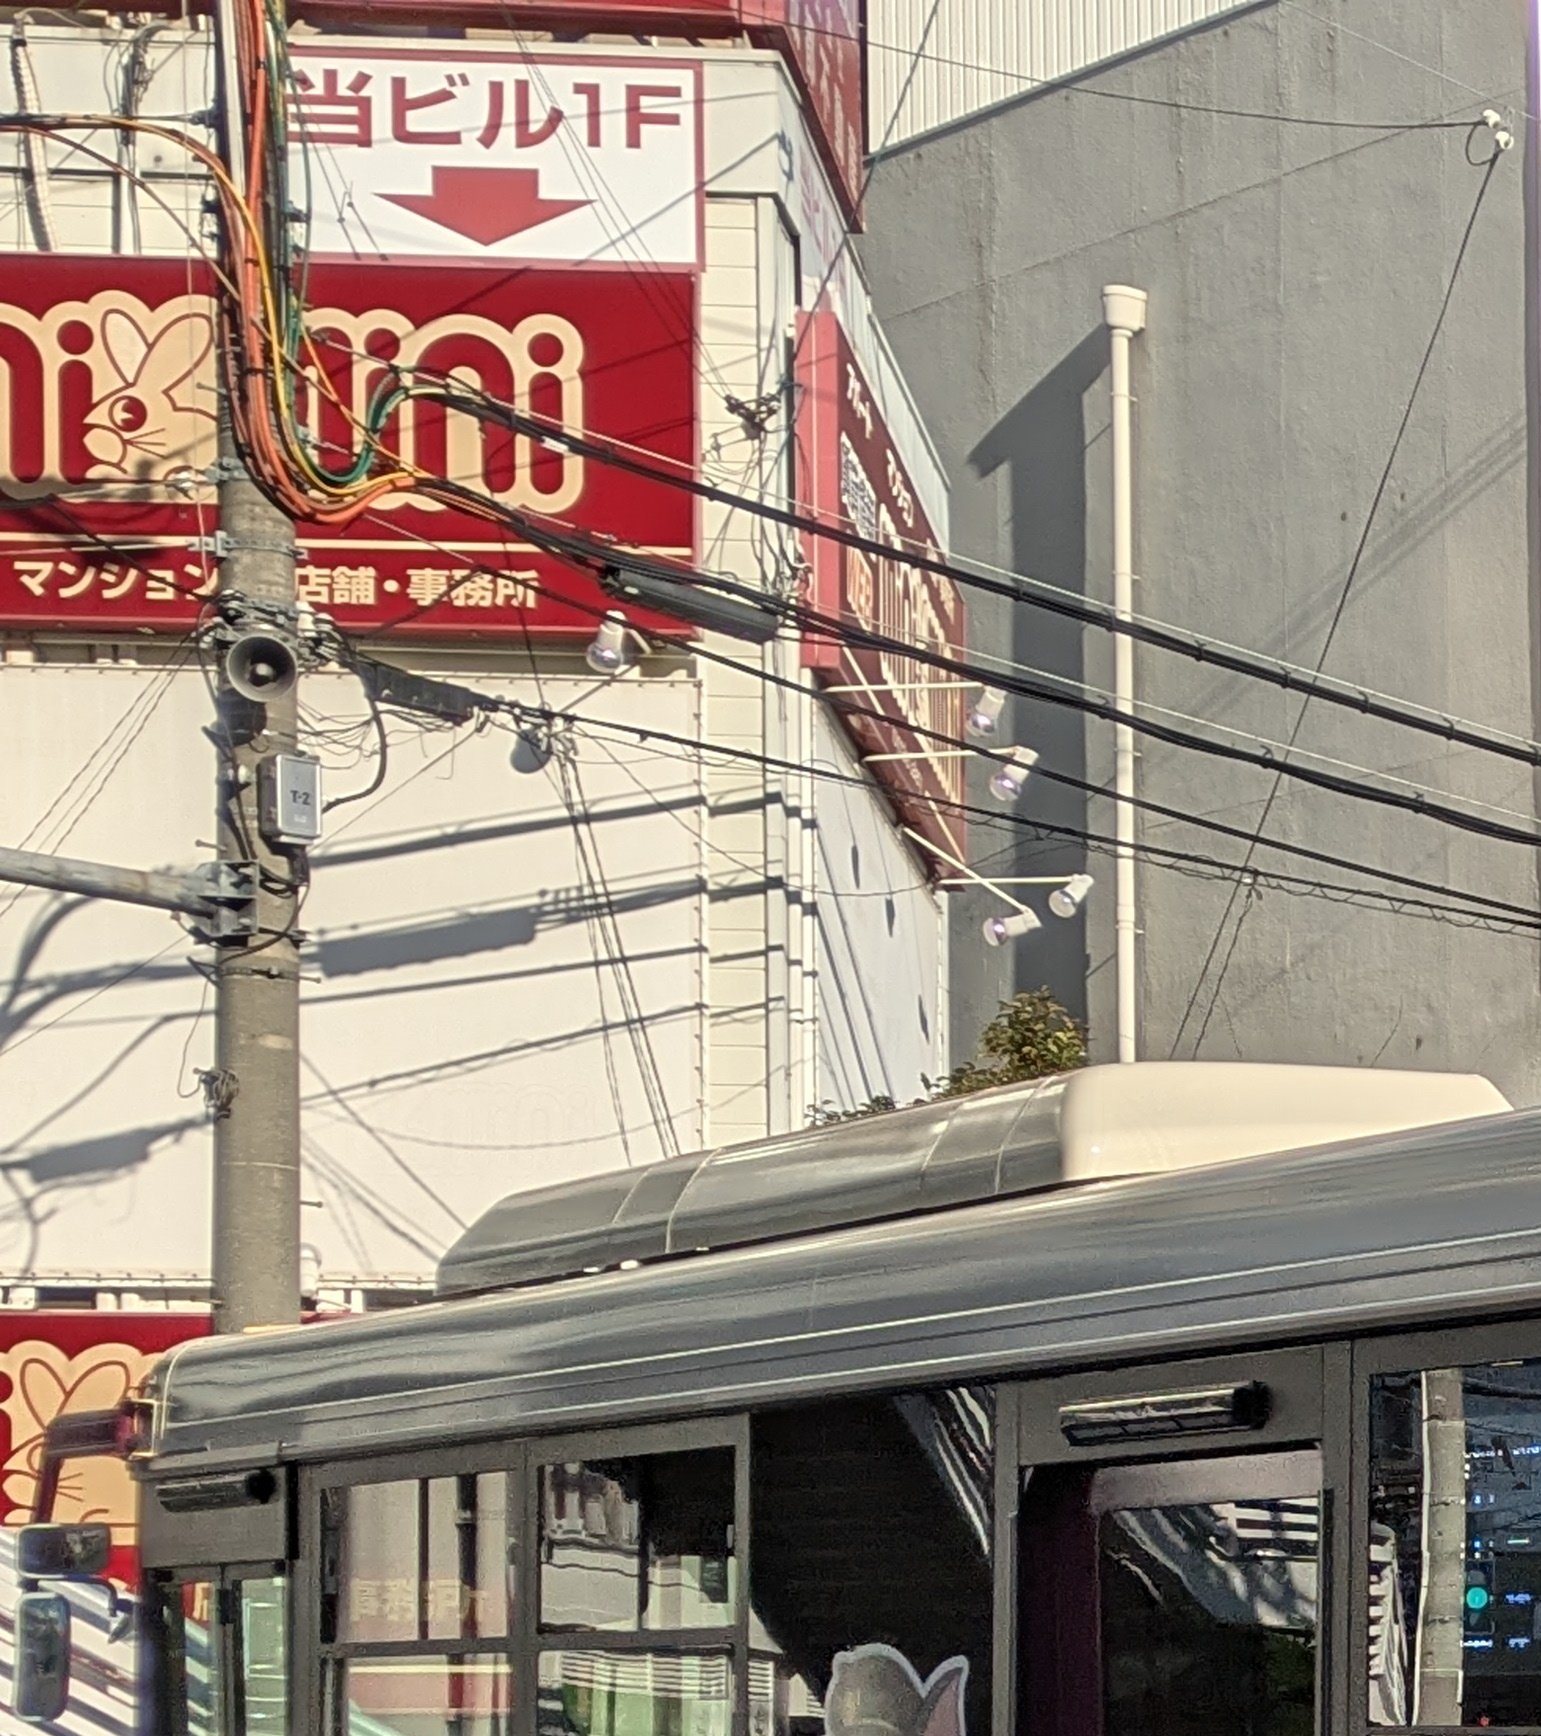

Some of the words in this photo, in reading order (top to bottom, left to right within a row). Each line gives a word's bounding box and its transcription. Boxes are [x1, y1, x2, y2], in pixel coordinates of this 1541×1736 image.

[287, 68, 683, 149] 当ビル1F
[290, 790, 312, 807] T-2
